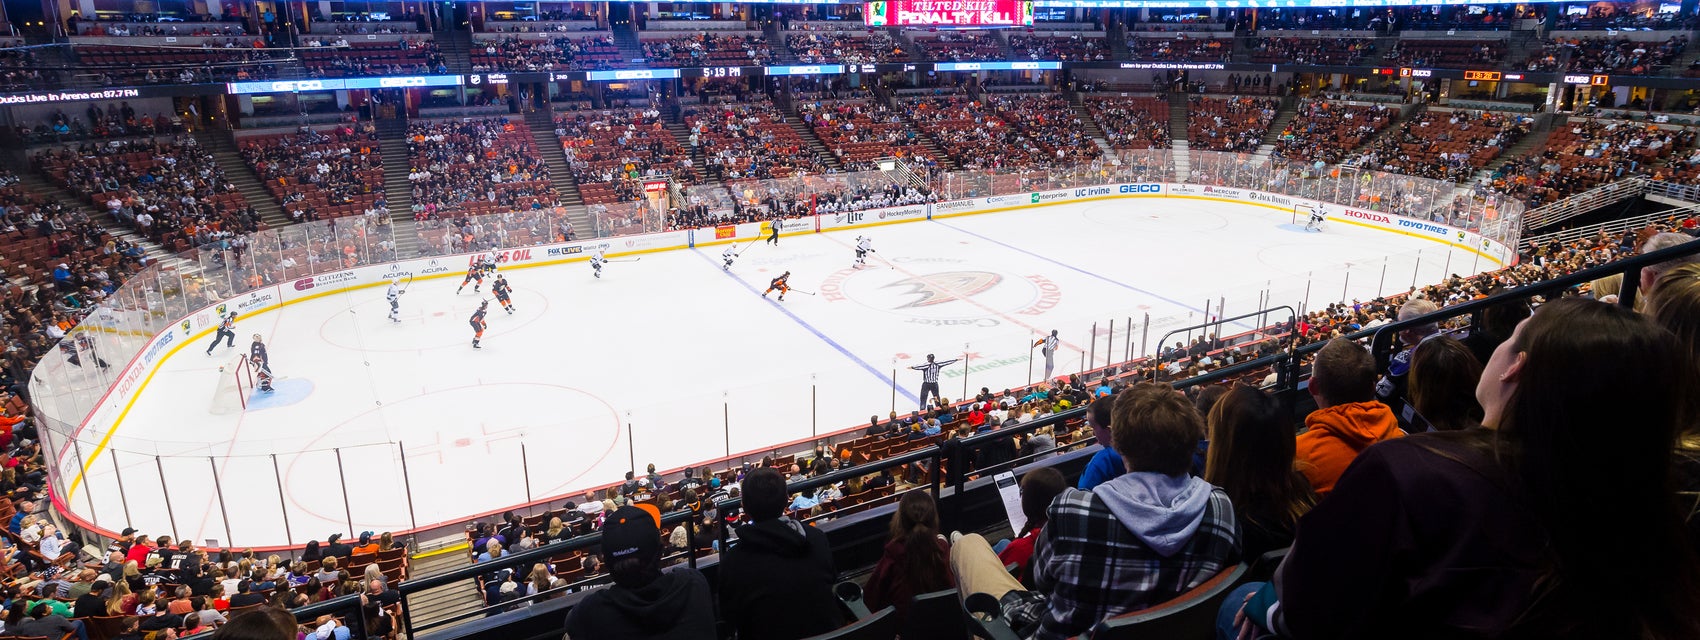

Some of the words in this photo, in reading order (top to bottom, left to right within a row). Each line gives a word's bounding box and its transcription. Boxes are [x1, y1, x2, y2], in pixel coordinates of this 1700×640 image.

[914, 1, 963, 11] TILTED
[966, 1, 996, 11] KILT
[901, 11, 974, 24] PENALTY
[979, 11, 1013, 24] KILL
[703, 68, 726, 78] 5:19
[729, 67, 741, 77] PM
[1564, 75, 1590, 83] KINGS
[26, 94, 48, 103] Live
[61, 92, 90, 100] Arena
[104, 90, 124, 98] 87.7
[125, 89, 139, 97] FM
[1088, 187, 1110, 196] Irvine
[1119, 184, 1160, 193] GEICO
[1213, 188, 1240, 196] MERCURY
[847, 211, 864, 224] Lite
[886, 209, 922, 217] HockeyMonkey
[1344, 209, 1391, 224] HONDA
[1398, 219, 1424, 230] TOYO
[1423, 224, 1449, 235] TIRES
[512, 249, 532, 261] OIL
[382, 271, 410, 279] ACURA
[421, 266, 449, 274] ACURA
[318, 271, 354, 282] CITIZENS
[1018, 274, 1062, 316] HONDA
[942, 353, 1029, 379] Heineken
[118, 364, 145, 399] HONDA
